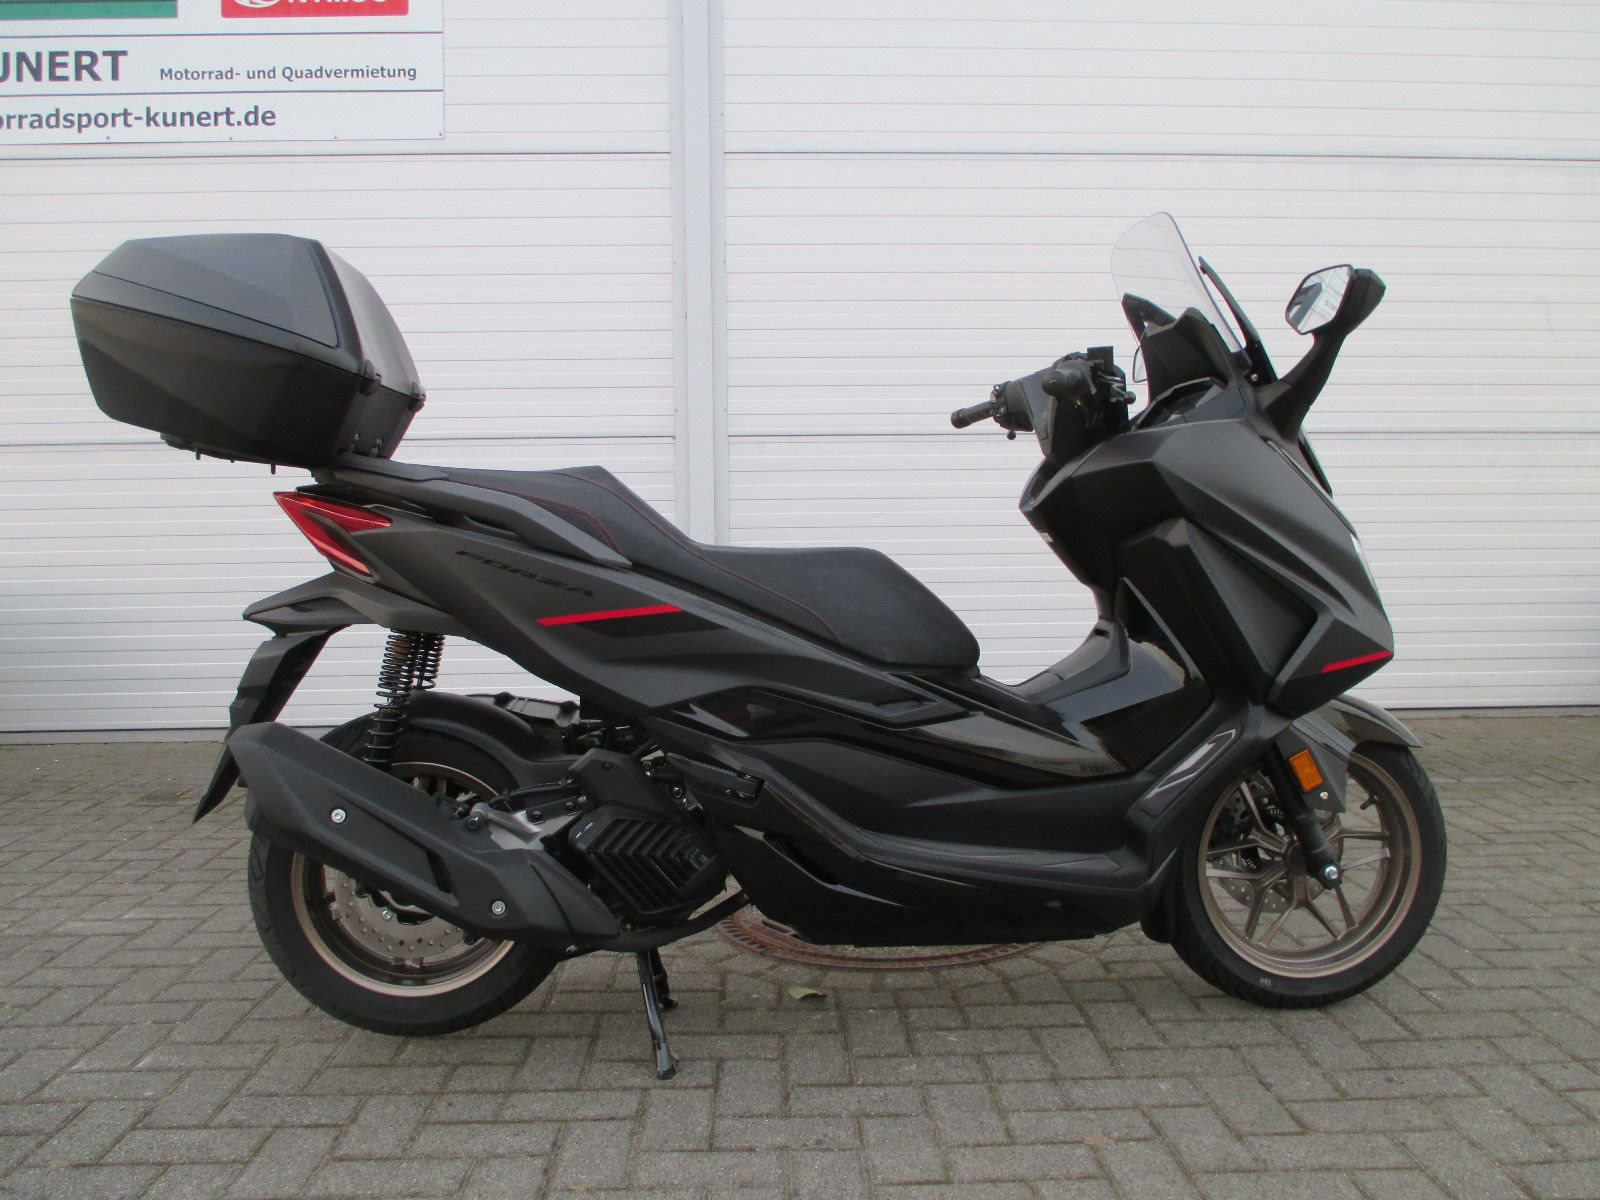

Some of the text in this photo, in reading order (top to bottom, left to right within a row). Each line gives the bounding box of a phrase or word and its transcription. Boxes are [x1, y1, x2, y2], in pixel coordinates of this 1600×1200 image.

[160, 65, 417, 82] Motorrad- und Quadvermietung
[0, 105, 276, 133] rradsport-kunert.de
